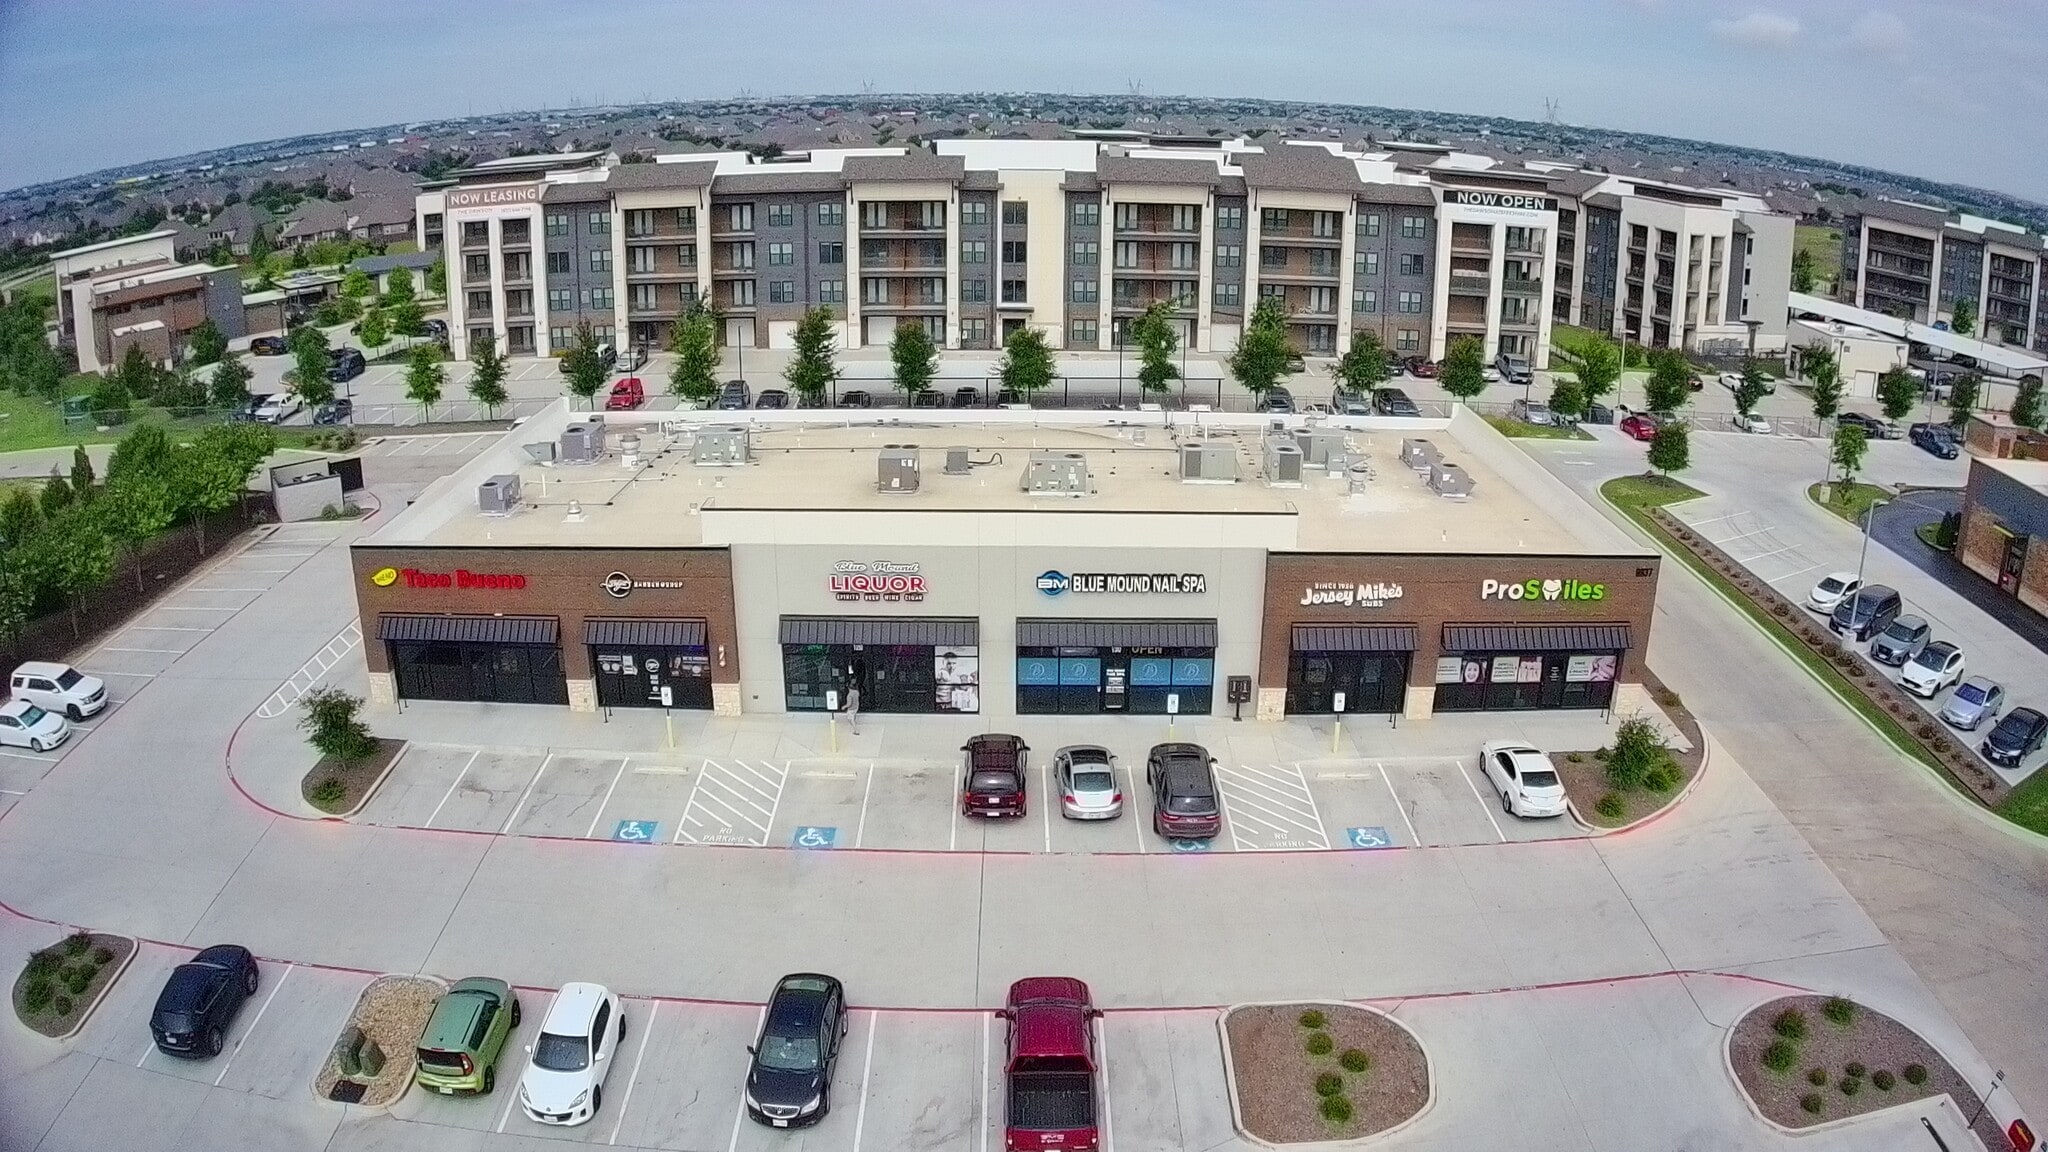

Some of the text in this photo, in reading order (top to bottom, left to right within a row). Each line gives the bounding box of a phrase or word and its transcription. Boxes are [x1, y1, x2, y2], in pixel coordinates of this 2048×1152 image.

[451, 188, 536, 205] NOW LEASING
[1457, 191, 1546, 210] NOW OPEN
[834, 560, 920, 573] Blue Mound
[401, 568, 526, 589] Taco Bueno
[829, 573, 928, 593] LIQUOR
[1072, 574, 1206, 593] BLUE MOUND NAIL SPA
[1314, 582, 1336, 590] SINCE
[1300, 583, 1403, 606] Jersey Mike's
